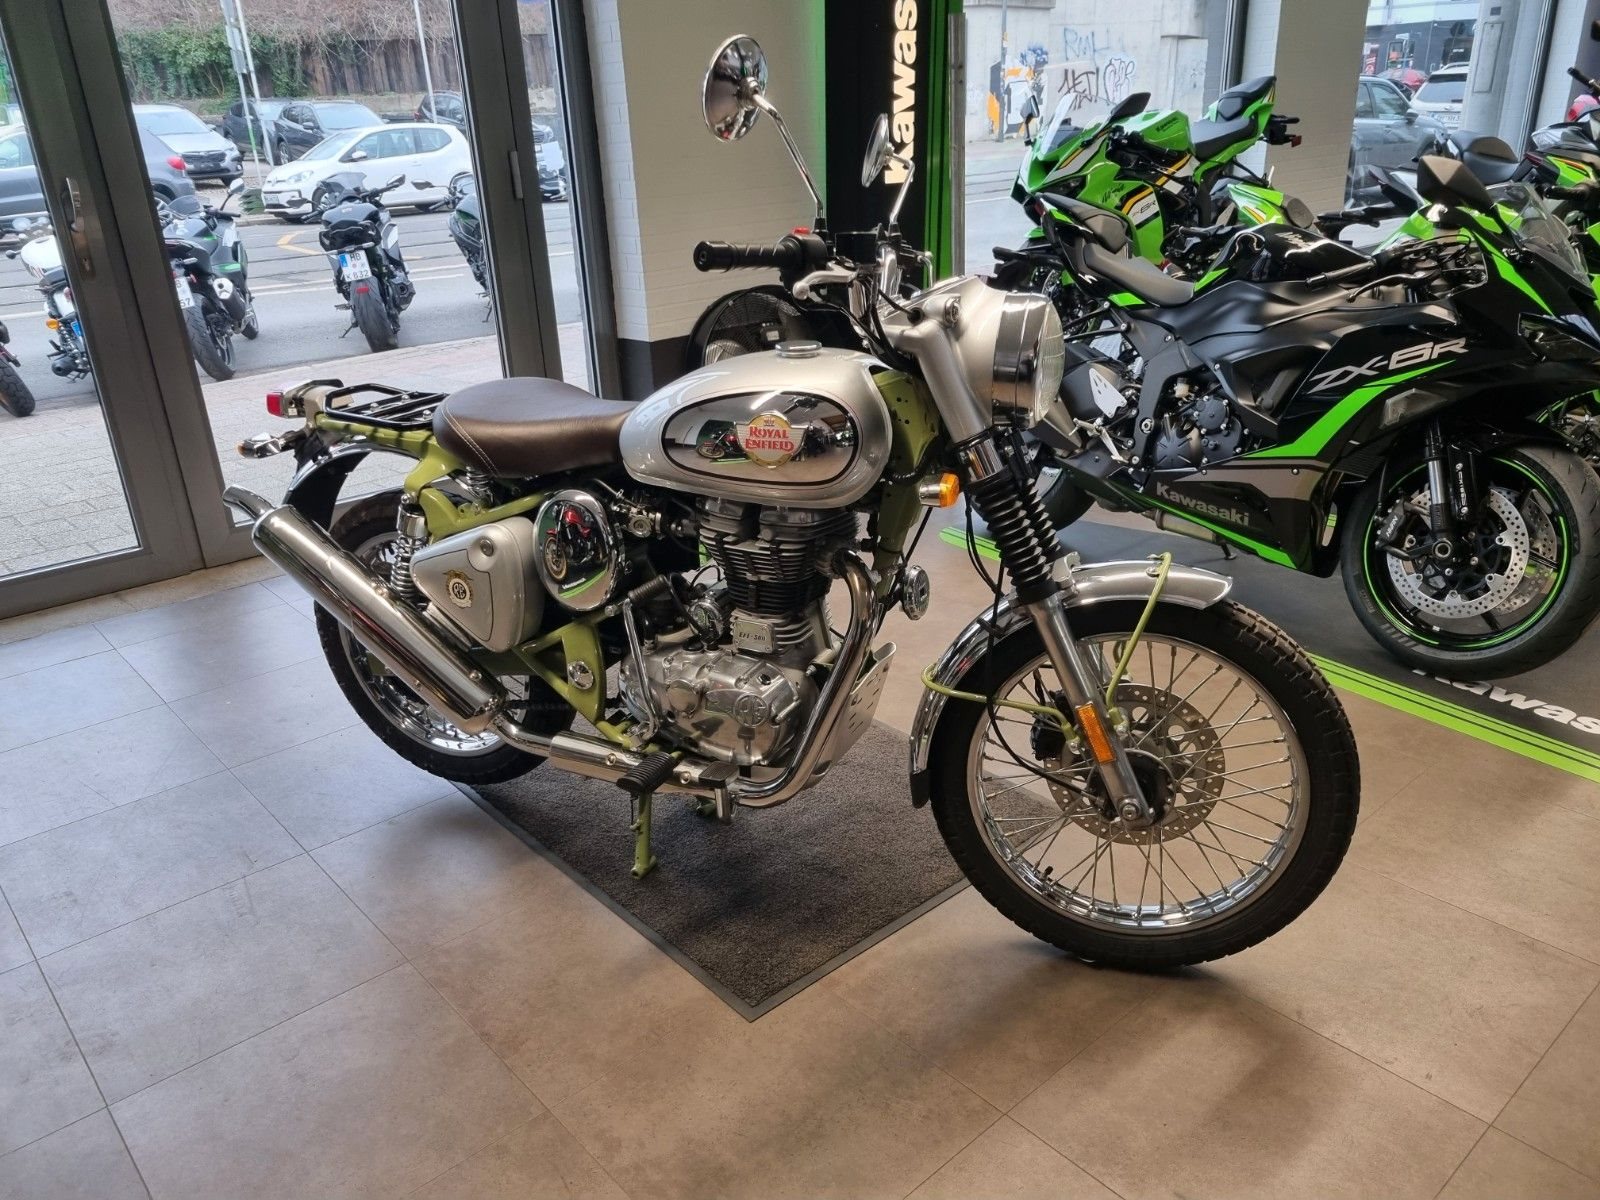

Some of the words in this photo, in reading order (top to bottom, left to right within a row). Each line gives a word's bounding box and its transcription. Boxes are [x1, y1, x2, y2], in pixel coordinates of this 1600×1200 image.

[1307, 337, 1469, 394] ZX-6R
[745, 438, 795, 452] ENFIELD
[749, 426, 789, 439] ROYAL
[1156, 481, 1250, 527] Kawasaki
[1412, 668, 1600, 735] awas
